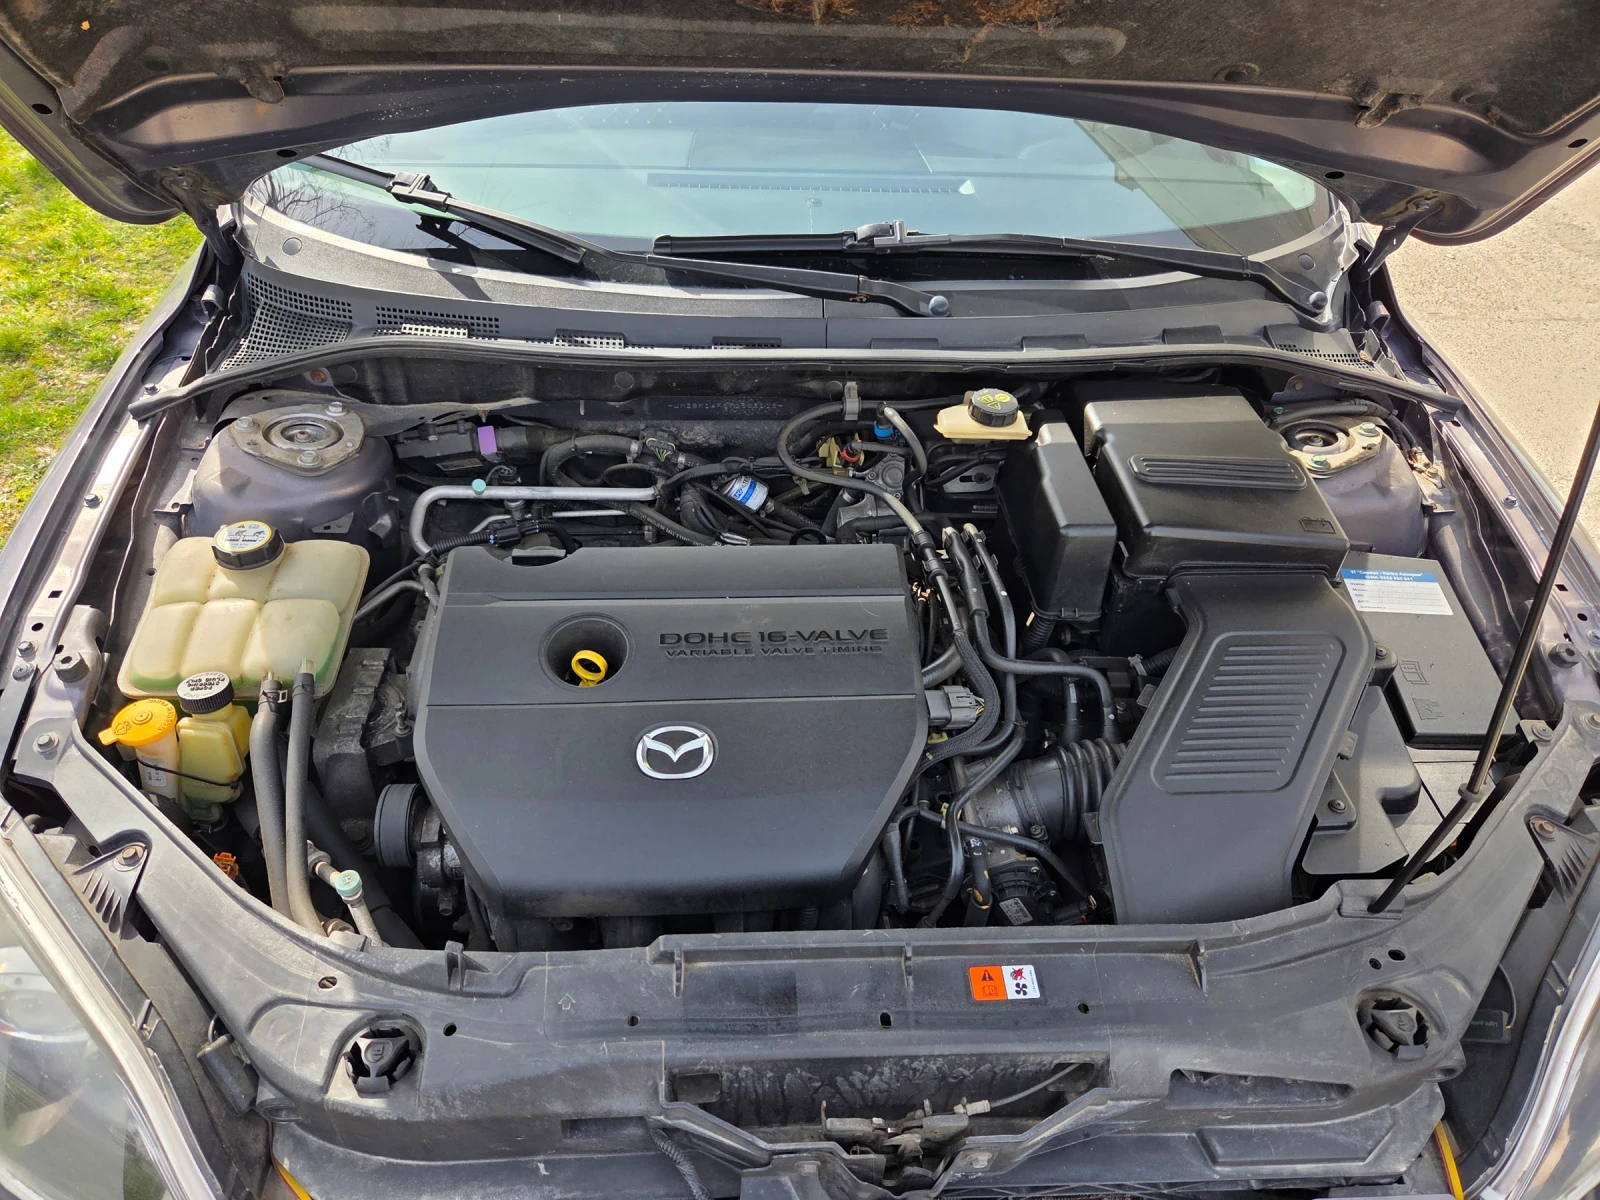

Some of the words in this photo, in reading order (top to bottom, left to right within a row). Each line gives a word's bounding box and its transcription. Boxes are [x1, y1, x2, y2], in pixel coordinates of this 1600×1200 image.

[659, 630, 752, 646] DOHC
[757, 628, 890, 643] 16-VALVE
[665, 648, 756, 657] VARIABLE
[760, 646, 815, 656] VALVE
[821, 645, 883, 654] TIMING
